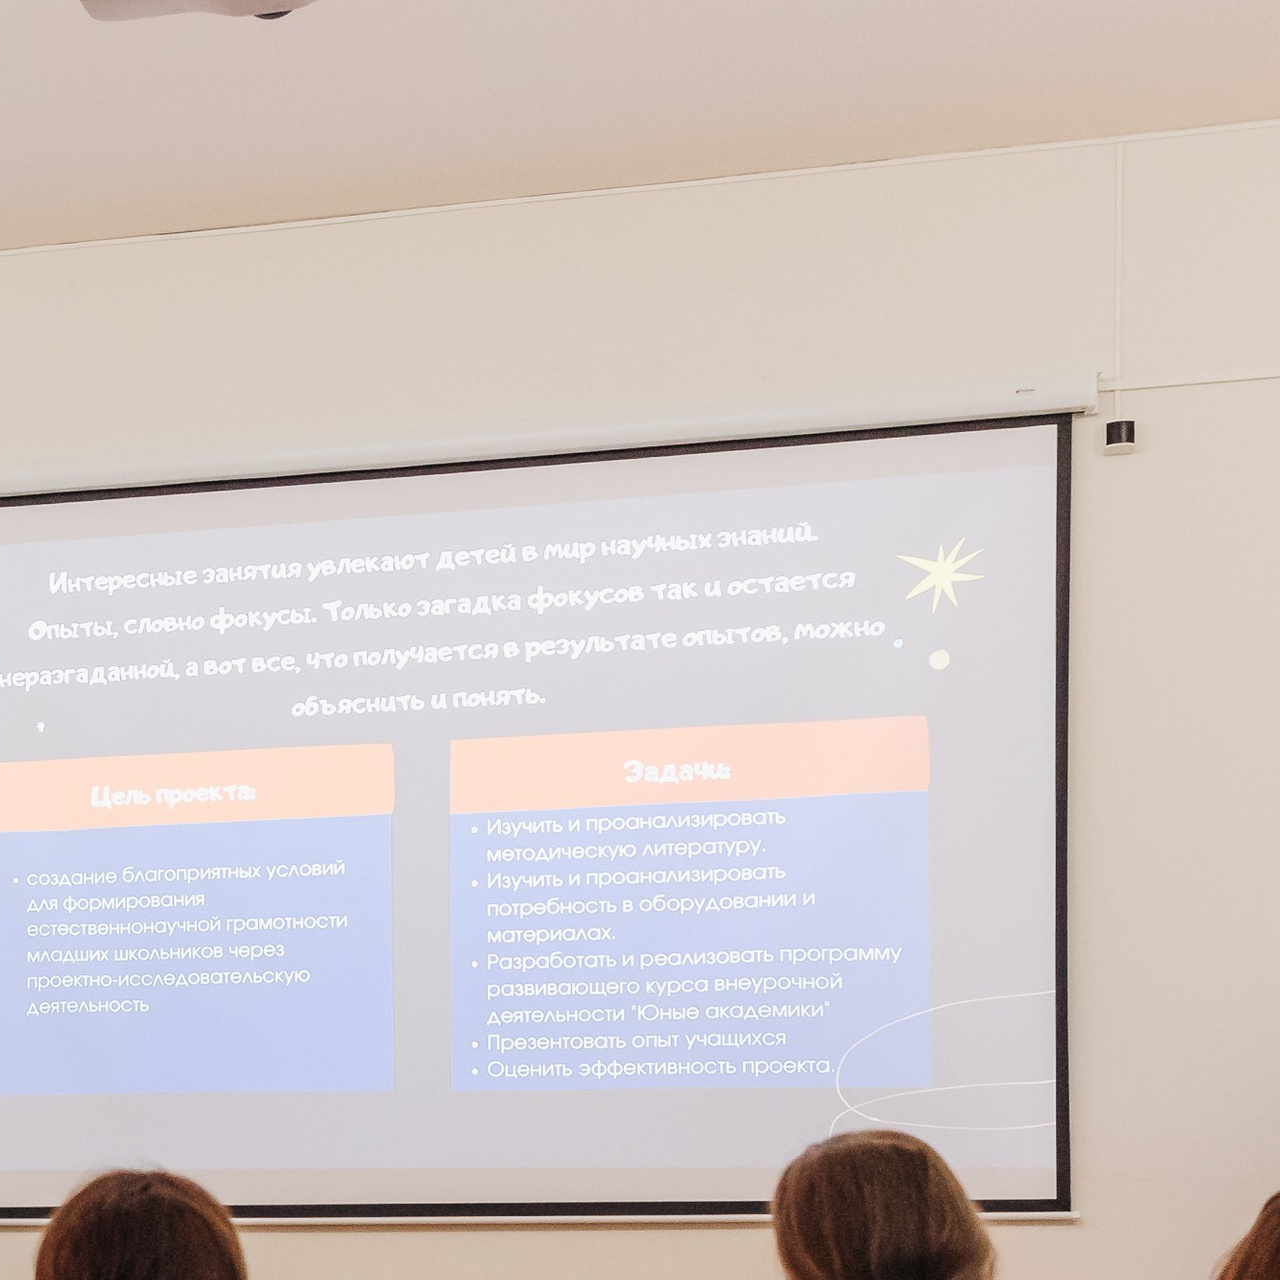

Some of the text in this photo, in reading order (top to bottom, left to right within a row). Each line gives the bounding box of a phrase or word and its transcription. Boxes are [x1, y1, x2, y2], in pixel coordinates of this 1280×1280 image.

[48, 521, 819, 596] Интересные занятия увлекают детей в мир научных знаний.
[28, 571, 856, 641] Опыты, словно фокусы. Только загадка фокусов так и остается
[185, 660, 199, 677] а
[203, 657, 247, 676] вот
[251, 655, 301, 675] все,
[305, 651, 349, 670] что
[352, 642, 499, 670] получается
[502, 641, 521, 658] в
[524, 632, 678, 663] результате
[682, 625, 789, 648] опытов,
[793, 620, 886, 640] можно
[291, 688, 546, 717] объяснить и понять.
[623, 759, 732, 785] Задачи:
[90, 783, 257, 810] Цель проекта:
[487, 811, 787, 838] Изучить и проанализировать
[486, 839, 766, 863] методическую литературу.
[26, 859, 346, 888] создание благоприятных условий
[487, 866, 786, 892] Изучить и проанализировать
[26, 893, 205, 914] для формирования
[486, 892, 816, 920] потребность в оборудовании и
[26, 915, 348, 937] естественнонаучной грамотности
[487, 927, 616, 946] материалах.
[27, 943, 285, 964] младших школьников через
[487, 947, 903, 973] Разработать и реализовать программу
[27, 969, 311, 992] проектно-исследовательскую
[487, 971, 843, 1001] развивающего курса внеурочной
[26, 999, 150, 1017] деятельность
[486, 1000, 830, 1027] деятельности "Юные академики"
[487, 1032, 787, 1054] Презентовать опыт учащихся
[487, 1059, 835, 1080] Оценить эффективность проекта.
